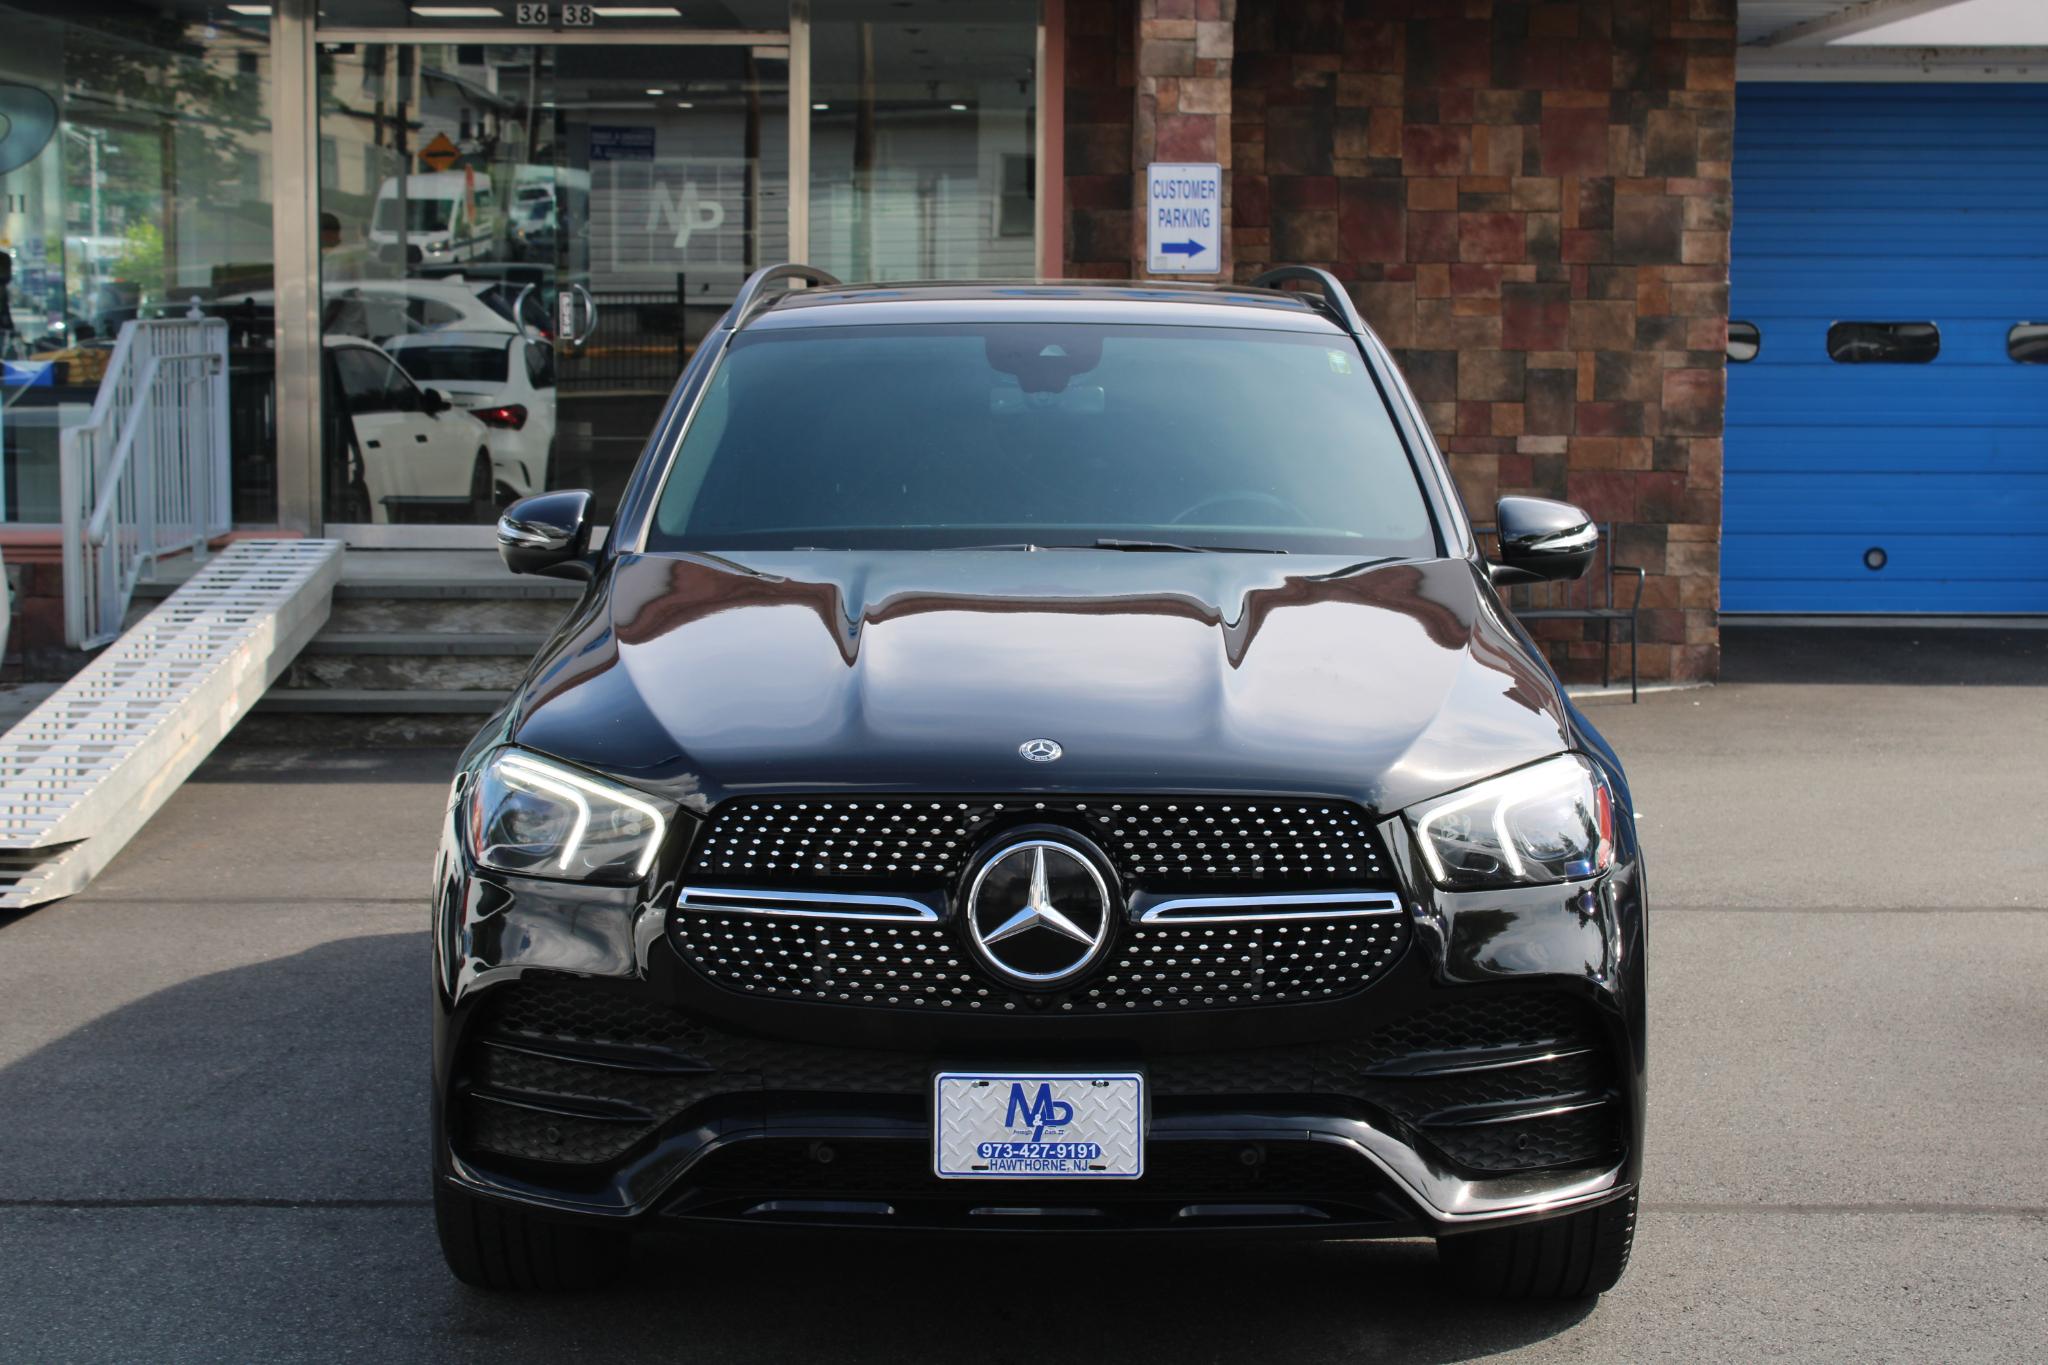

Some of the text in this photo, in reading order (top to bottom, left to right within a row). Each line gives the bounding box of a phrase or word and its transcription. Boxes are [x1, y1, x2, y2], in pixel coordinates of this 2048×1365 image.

[520, 5, 590, 23] 36 38
[1153, 180, 1216, 199] CUSTOMER
[1158, 208, 1210, 228] PARKING
[982, 1144, 1096, 1158] 973-427-9191
[990, 1159, 1088, 1172] HAWTHORNE, NJ
